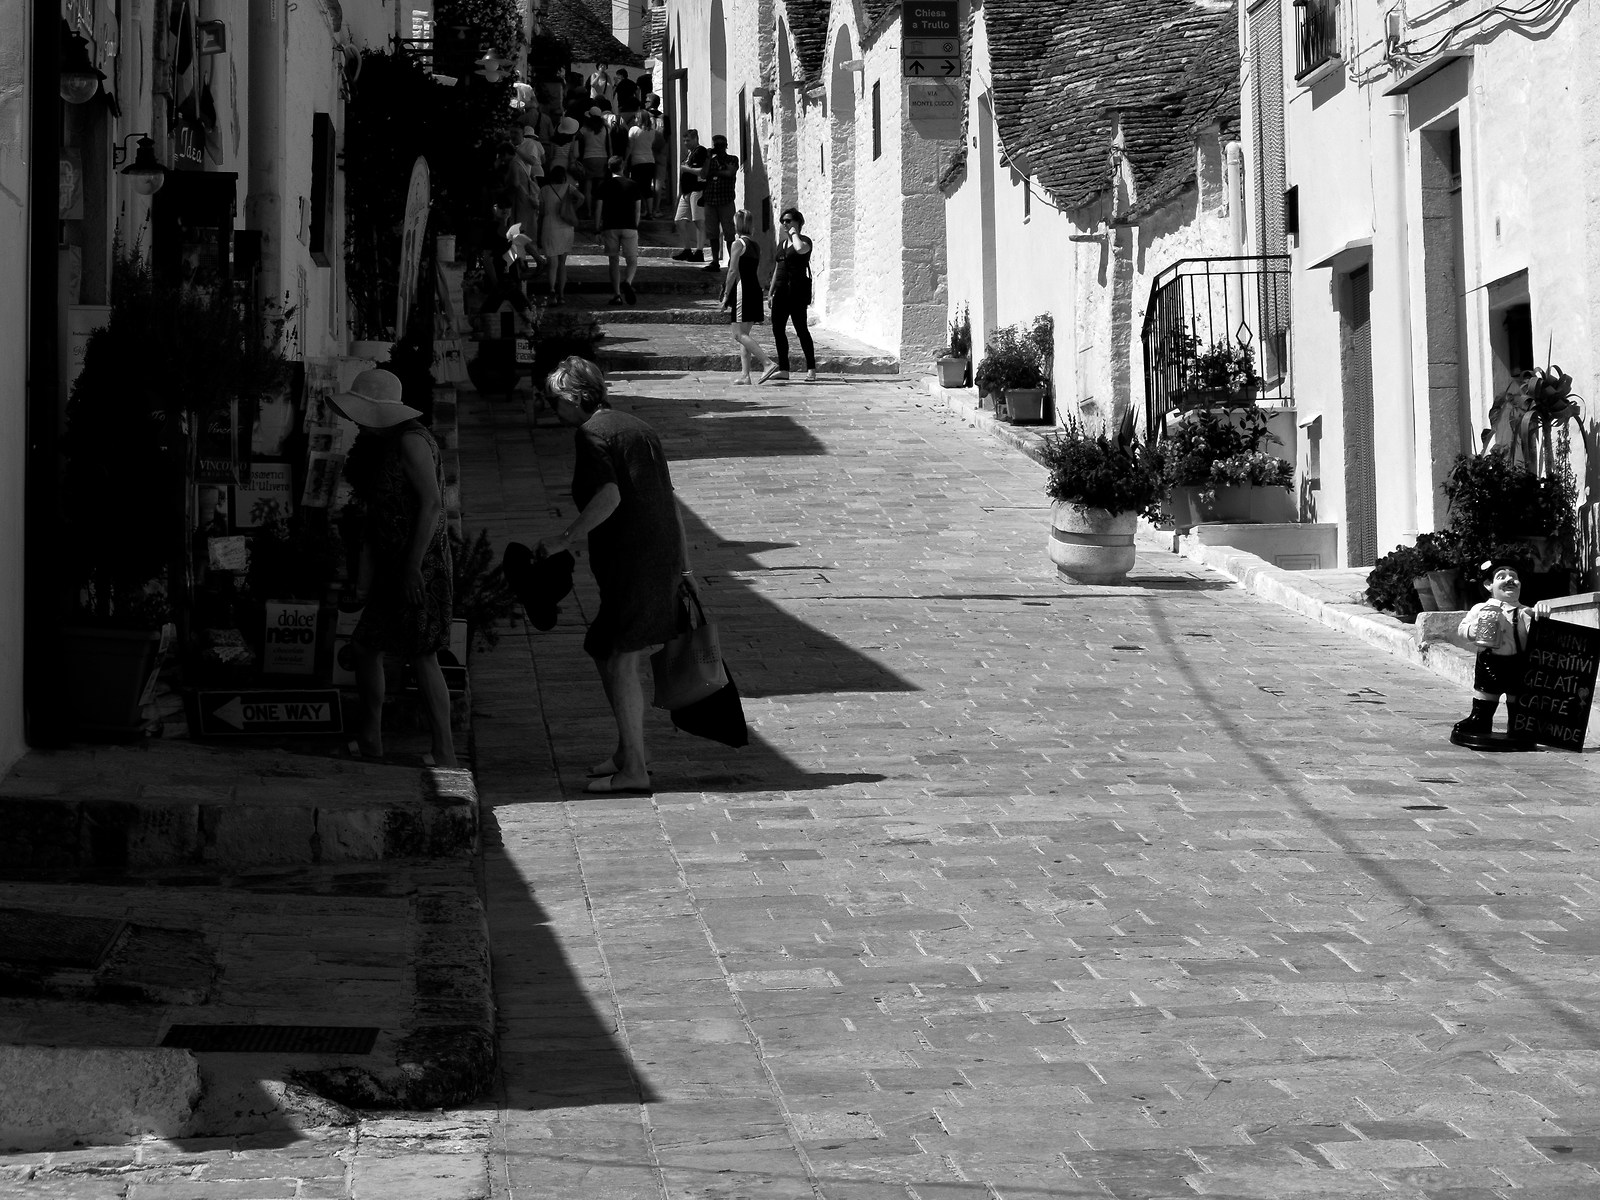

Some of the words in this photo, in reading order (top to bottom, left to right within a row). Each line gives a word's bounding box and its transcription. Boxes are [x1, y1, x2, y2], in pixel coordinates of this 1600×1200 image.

[914, 8, 947, 17] Chiesa
[921, 20, 950, 29] Trullo
[278, 609, 314, 627] dolce
[267, 627, 314, 644] nero
[243, 704, 280, 720] ONE
[285, 704, 323, 720] WAY
[1514, 713, 1582, 743] BEVANDE
